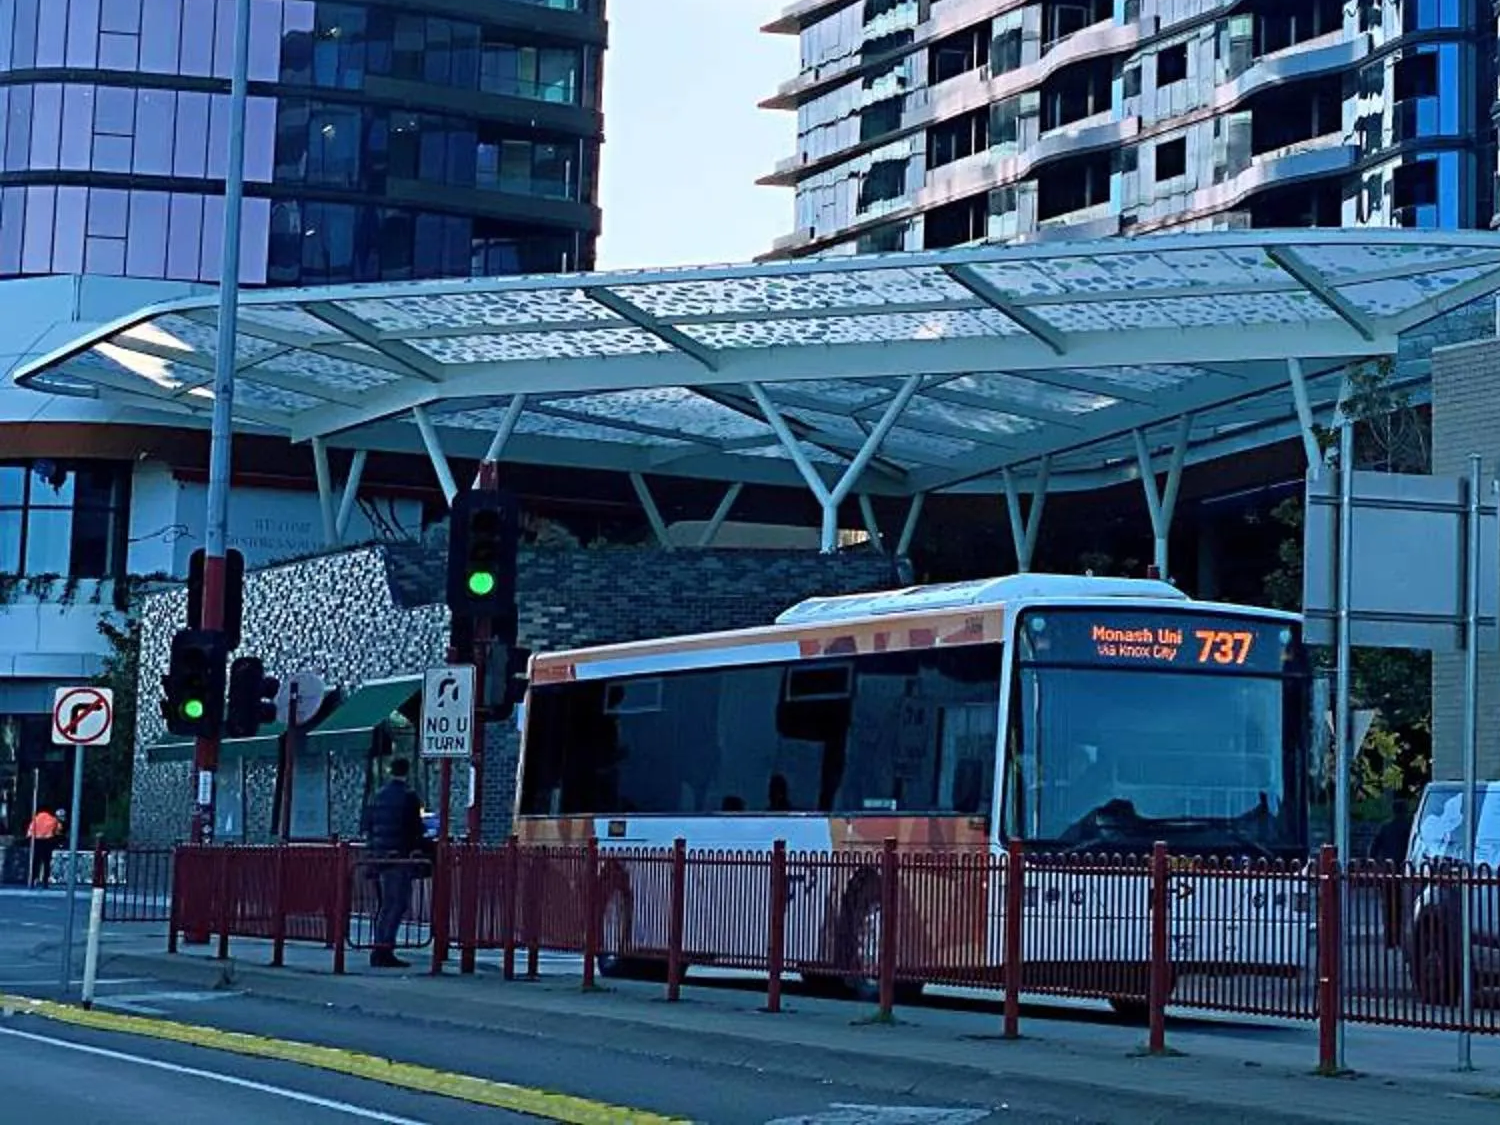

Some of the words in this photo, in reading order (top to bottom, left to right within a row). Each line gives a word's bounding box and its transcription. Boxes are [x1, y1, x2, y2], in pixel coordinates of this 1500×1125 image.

[1092, 625, 1153, 644] Monash
[1158, 627, 1183, 645] Uni
[1195, 630, 1252, 665] 737
[427, 717, 449, 734] NO
[456, 717, 468, 734] U
[426, 736, 465, 750] TURN
